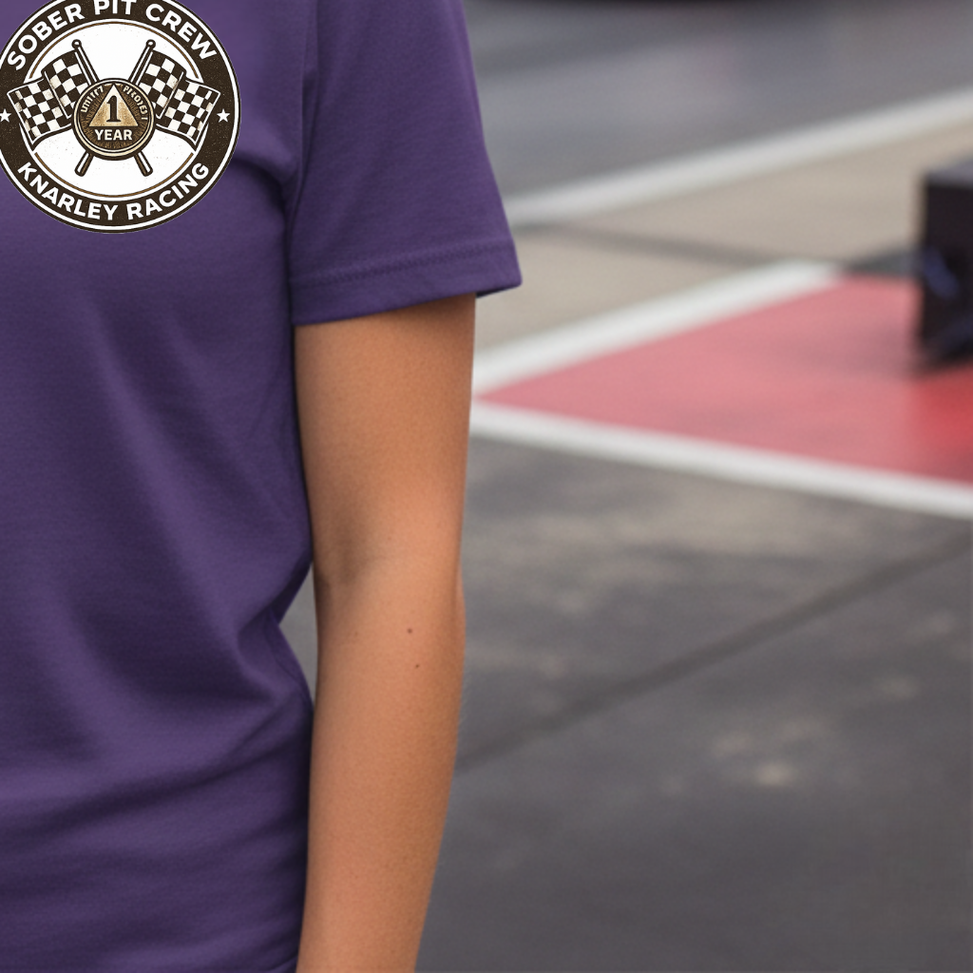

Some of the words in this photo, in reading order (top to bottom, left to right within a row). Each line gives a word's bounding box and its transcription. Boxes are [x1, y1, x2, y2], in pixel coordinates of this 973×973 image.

[7, 3, 86, 71] SOBER
[145, 3, 218, 61] CREW
[106, 95, 122, 123] 1
[94, 129, 133, 141] YEAR
[17, 161, 119, 221] KNARLEY
[126, 162, 210, 221] RACING
